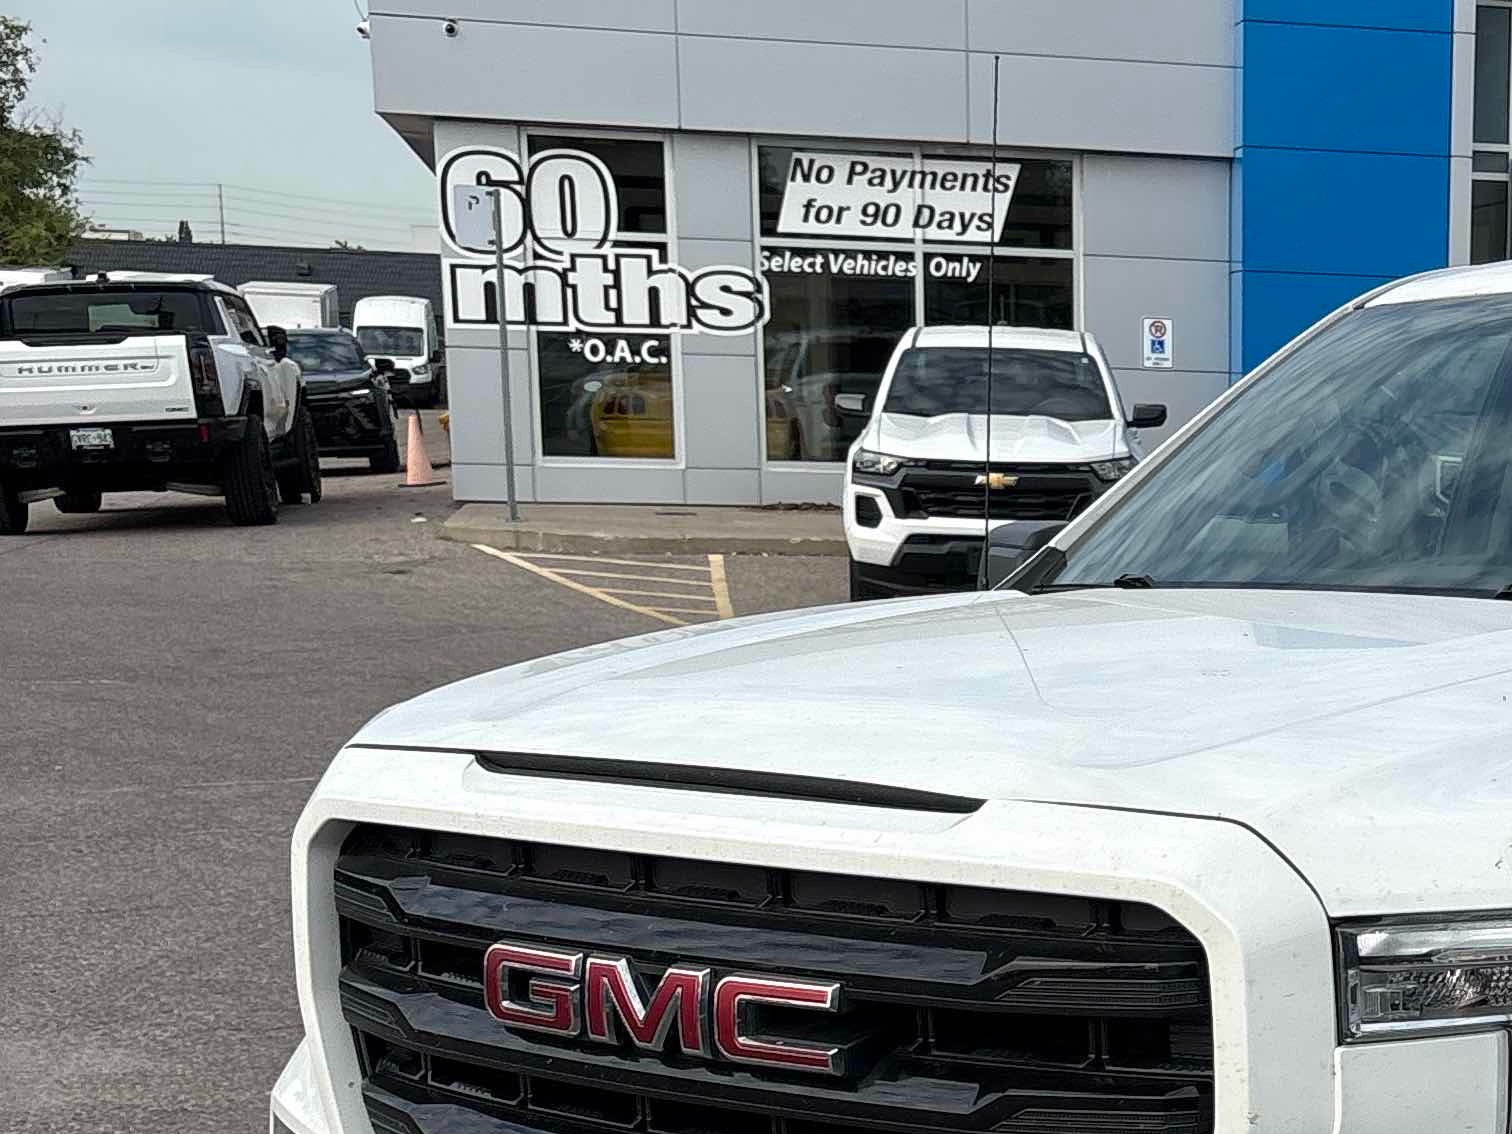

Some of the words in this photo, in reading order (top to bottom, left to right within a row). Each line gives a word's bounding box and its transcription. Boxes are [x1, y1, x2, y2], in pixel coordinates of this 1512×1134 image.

[790, 157, 835, 185] No
[846, 160, 1012, 194] Payments
[436, 145, 618, 260] 60
[802, 198, 851, 225] for
[859, 202, 902, 228] 90
[912, 204, 994, 236] Days
[758, 250, 824, 274] Select
[828, 252, 918, 278] Vehicles
[929, 256, 982, 283] Only
[441, 248, 772, 337] mths
[17, 361, 140, 376] HUMMER
[483, 941, 843, 1076] GMC
